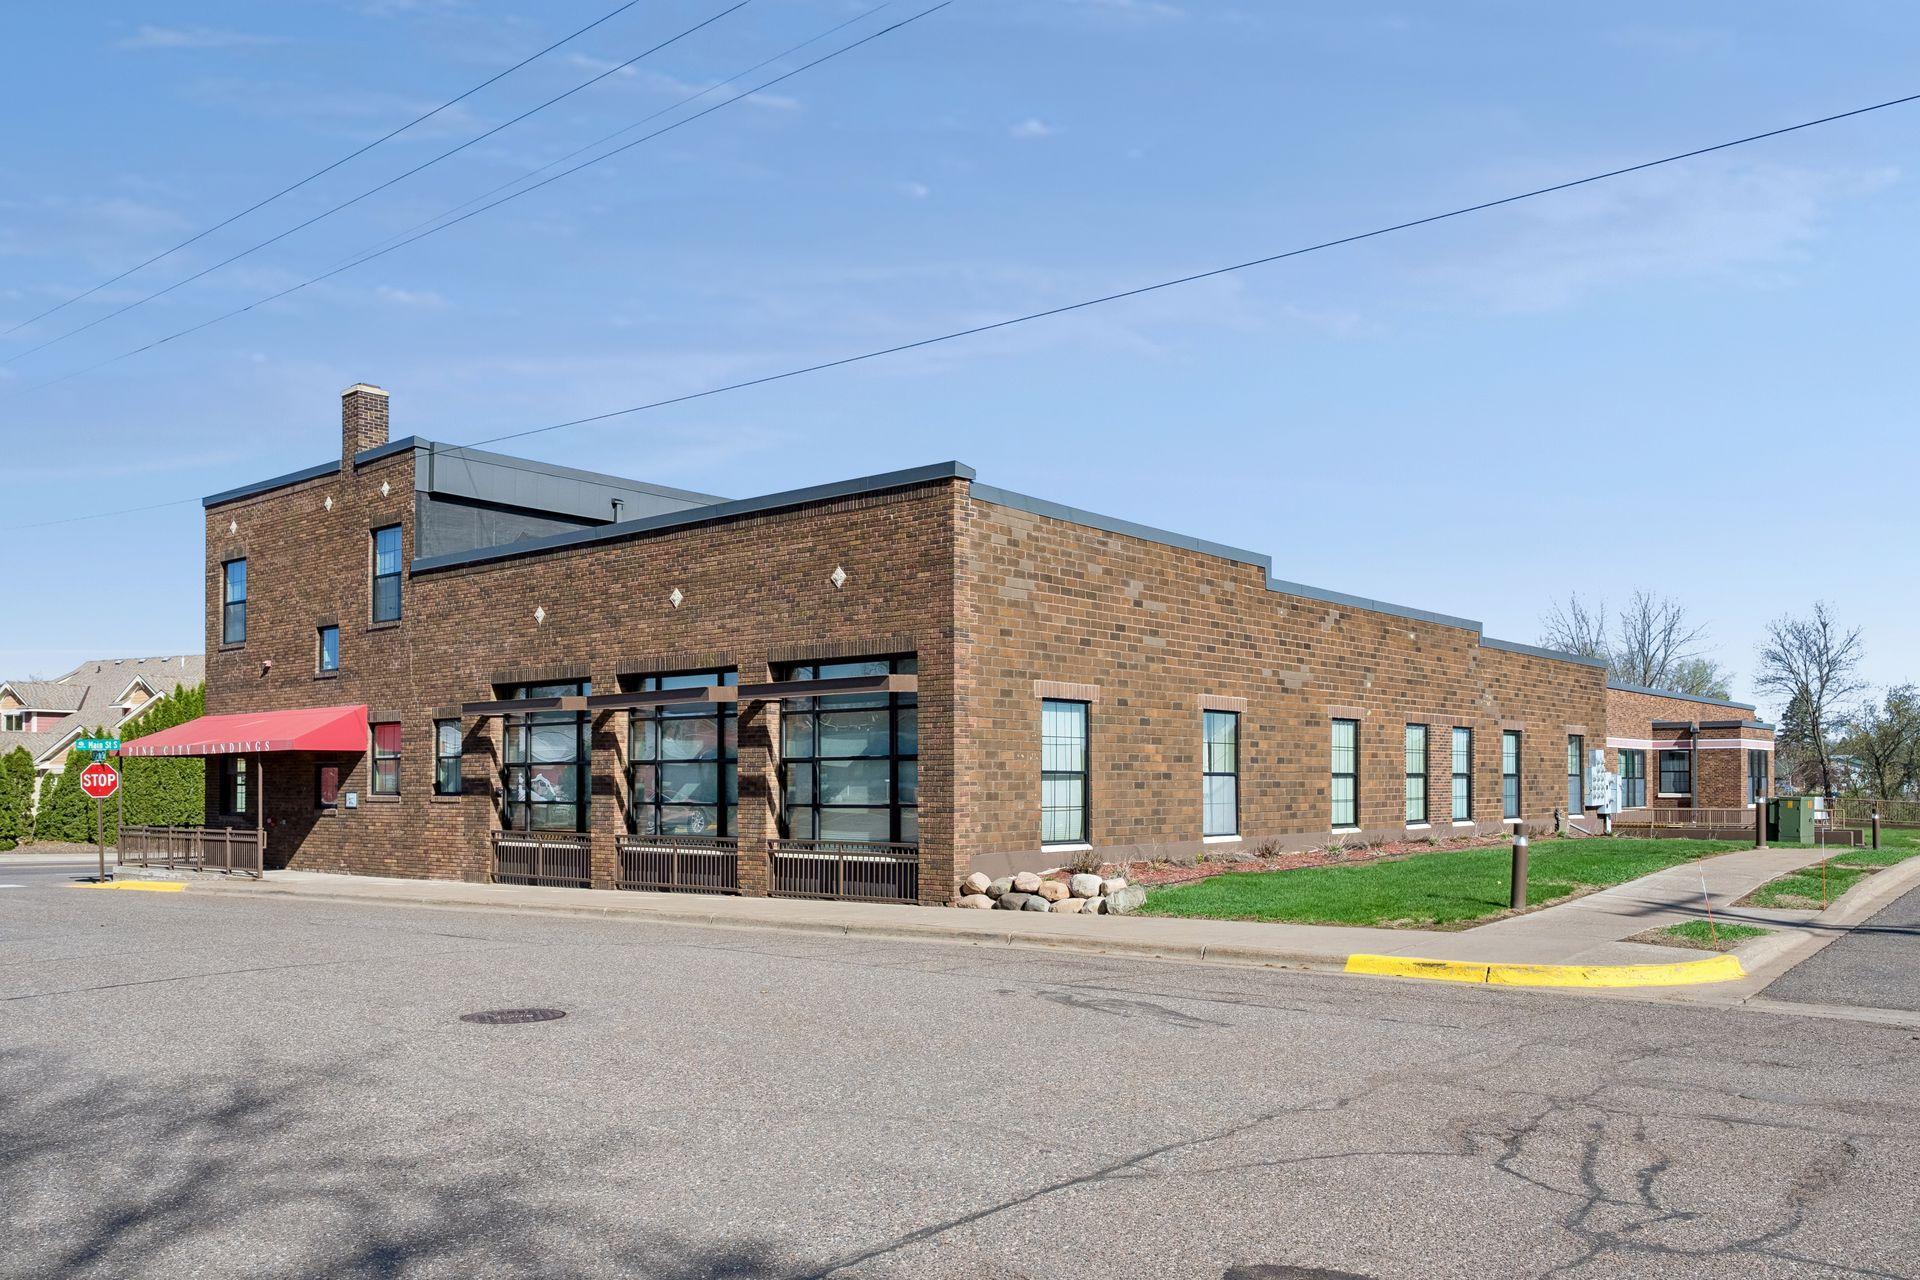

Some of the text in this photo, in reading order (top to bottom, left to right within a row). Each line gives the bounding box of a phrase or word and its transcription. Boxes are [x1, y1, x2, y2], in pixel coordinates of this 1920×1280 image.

[88, 741, 118, 749] Main St S
[128, 740, 270, 756] PINE CITY LANDINGS
[83, 774, 116, 787] STOP
